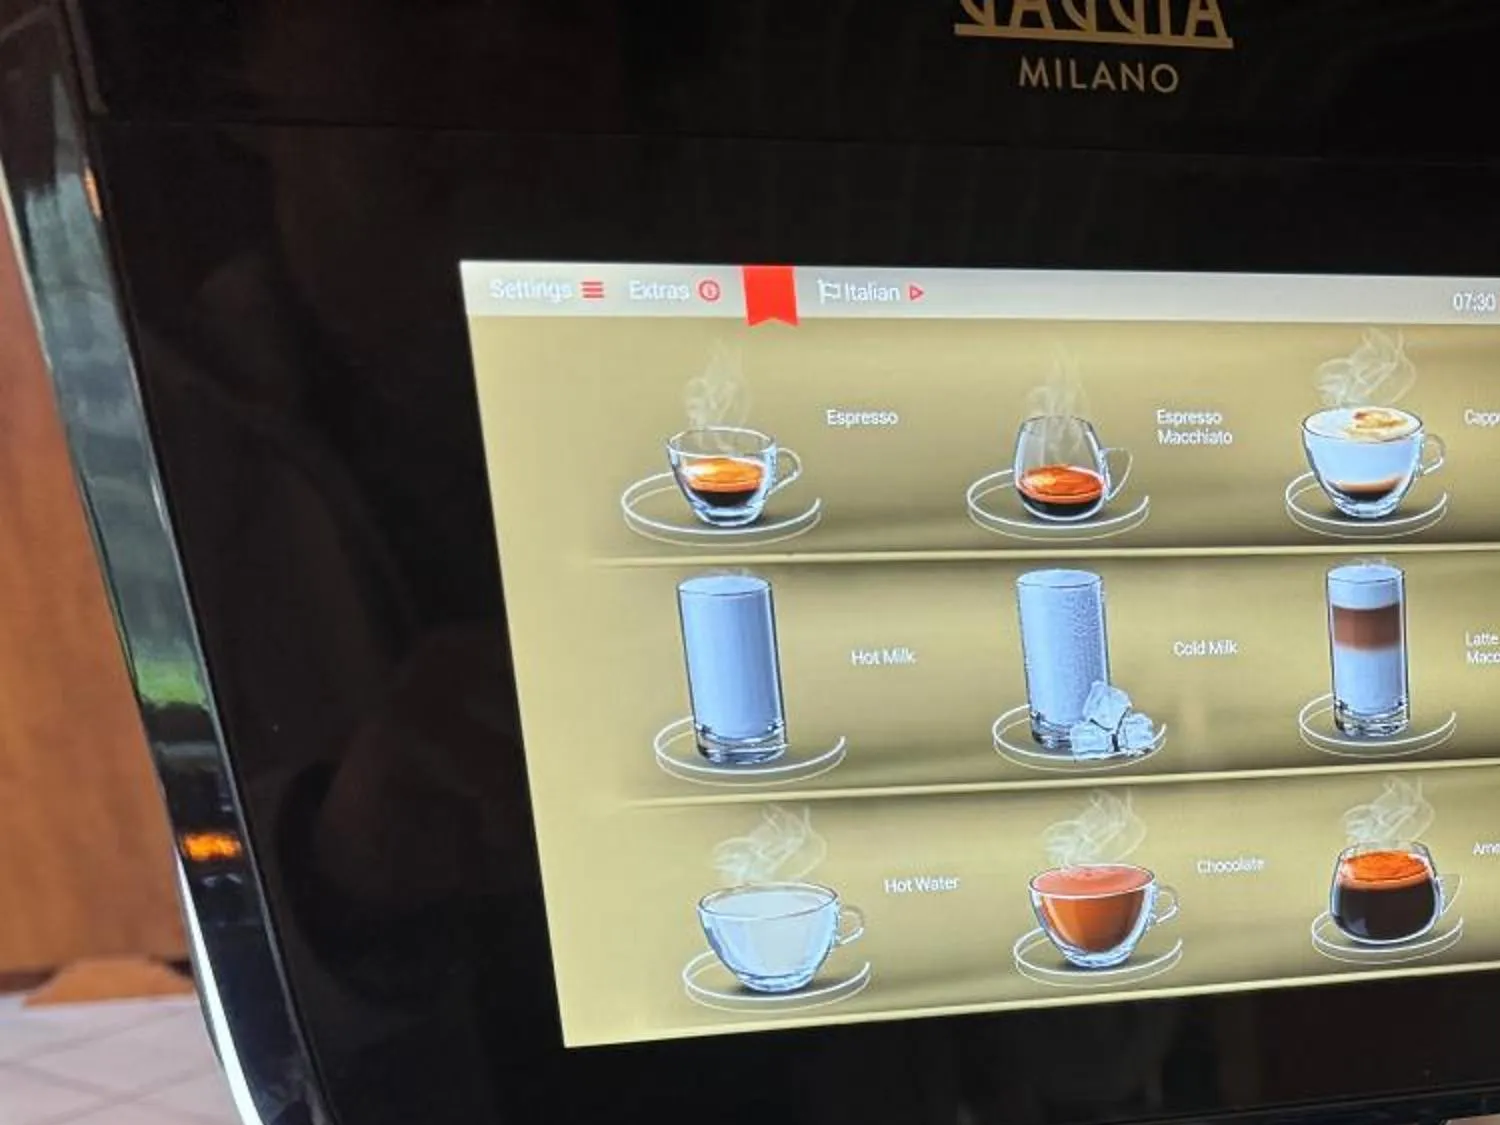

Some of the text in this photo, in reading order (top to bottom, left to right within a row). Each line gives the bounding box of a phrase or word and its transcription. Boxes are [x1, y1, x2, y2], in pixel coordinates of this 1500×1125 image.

[1019, 57, 1179, 94] MILANO
[489, 279, 574, 302] Settings
[629, 280, 690, 301] Extras
[844, 282, 901, 302] Italian
[1453, 293, 1496, 312] 07:30
[826, 409, 899, 428] Espresso
[1156, 409, 1224, 427] Espresso
[1157, 428, 1233, 445] Macchiato
[1173, 639, 1239, 656] Cold Milk
[1465, 631, 1500, 647] Latte
[851, 648, 917, 666] Hot Milk
[1196, 857, 1266, 874] Chocolate
[884, 877, 959, 893] Hot Water
